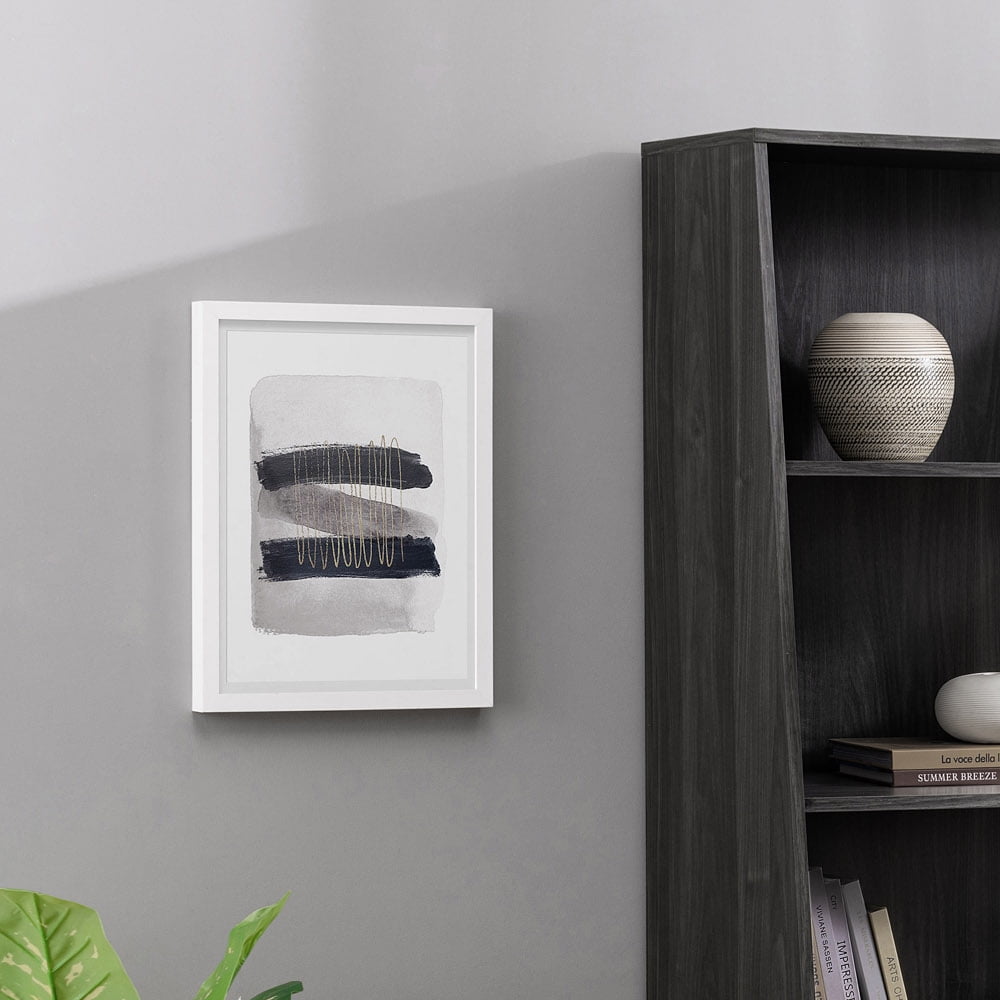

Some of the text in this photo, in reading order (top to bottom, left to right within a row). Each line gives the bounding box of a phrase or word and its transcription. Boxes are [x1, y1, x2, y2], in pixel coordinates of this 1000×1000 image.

[941, 754, 952, 764] La
[953, 755, 973, 764] voce
[975, 752, 996, 763] della
[917, 771, 998, 783] SUMMER BREEZE
[815, 905, 828, 938] VIVIANE
[822, 939, 834, 974] SASSEN
[886, 957, 899, 983] ARTS
